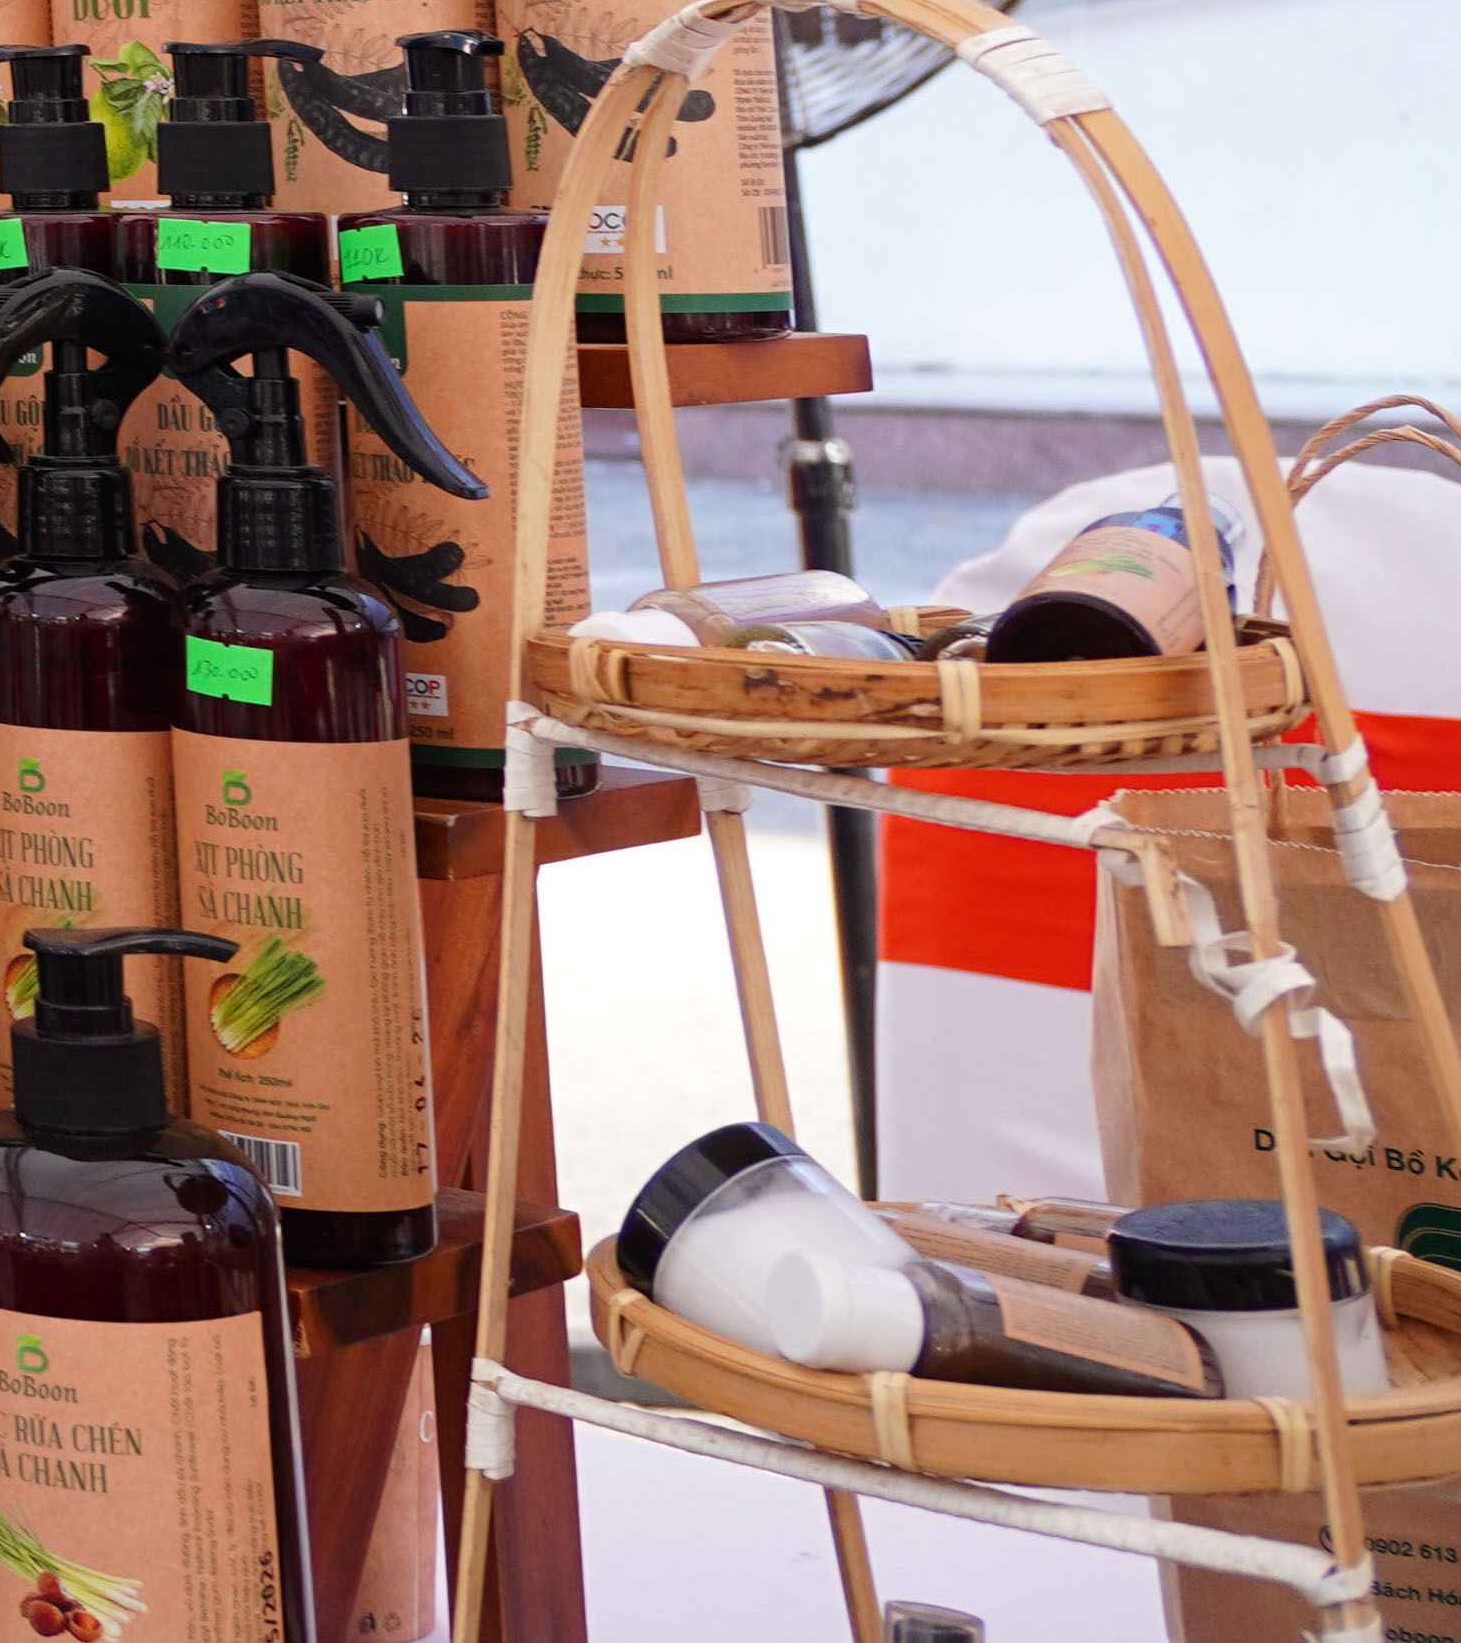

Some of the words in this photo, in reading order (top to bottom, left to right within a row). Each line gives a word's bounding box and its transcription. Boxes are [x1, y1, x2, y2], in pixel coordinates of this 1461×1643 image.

[157, 395, 192, 432] DẦU
[407, 679, 441, 694] COP
[1, 791, 71, 819] BoBoon
[205, 804, 279, 832] BoBoon
[19, 829, 94, 868] PHÒNG
[226, 843, 304, 884] PHÒNG
[18, 874, 92, 912] CHANH
[222, 890, 303, 929] CHANH
[1385, 1148, 1425, 1175] Bồ
[14, 1413, 63, 1449] RỬA
[72, 1421, 142, 1456] CHÉN
[18, 1453, 107, 1493] CHANH
[1420, 1544, 1458, 1564] 613
